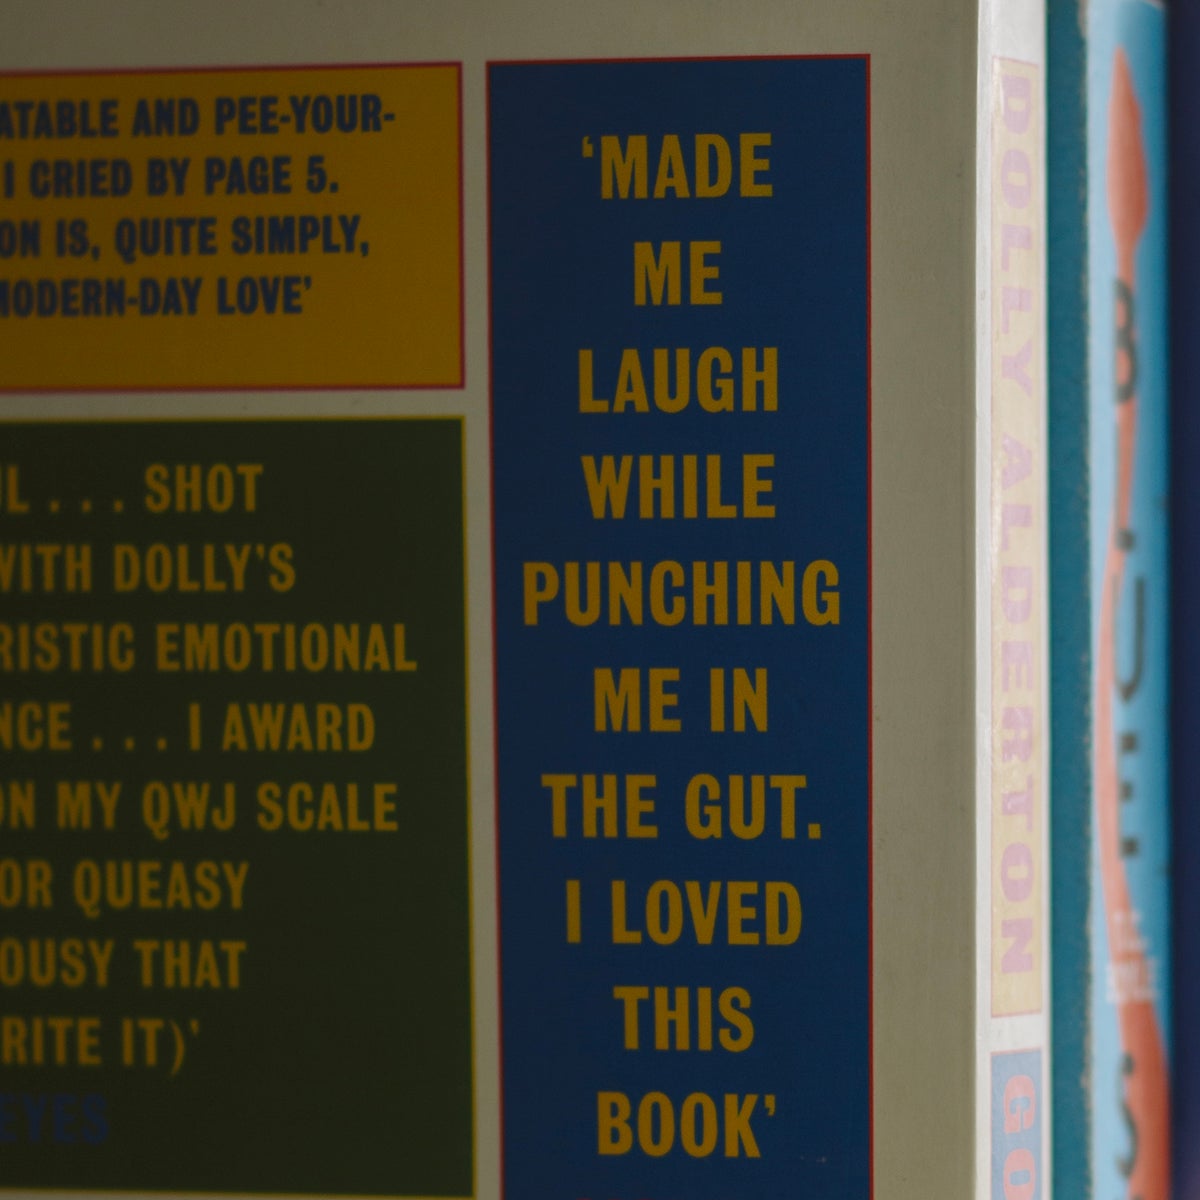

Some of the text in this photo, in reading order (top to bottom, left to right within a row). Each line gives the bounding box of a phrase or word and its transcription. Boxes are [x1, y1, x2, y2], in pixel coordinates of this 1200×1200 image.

[132, 98, 199, 137] AND
[215, 94, 396, 135] PEE-YOUR-
[4, 155, 339, 199] I CRIED BY PAGE 5.
[56, 218, 100, 261] IS,
[115, 216, 217, 264] QUITE
[231, 214, 369, 256] SIMPLY,
[634, 241, 723, 306] ME
[578, 347, 779, 414] LAUGH
[144, 463, 263, 513] SHOT
[581, 454, 776, 519] WHILE
[1000, 74, 1034, 974] DOLLY ALDERTON
[114, 542, 296, 592] DOLLY'S
[523, 560, 841, 627] PUNCHING
[157, 623, 417, 671] EMOTIONAL
[189, 704, 200, 750] I
[222, 703, 375, 751] AWARD
[593, 668, 768, 733] ME IN
[57, 782, 121, 829] MY
[142, 782, 235, 840] QWJ
[257, 783, 398, 831] SCALE
[541, 774, 821, 840] THE GUT.
[74, 860, 249, 918] QUEASY
[566, 880, 802, 946] I LOVED
[0, 939, 247, 988] OUSY THAT
[3, 1018, 101, 1066] RITE
[613, 986, 754, 1053] THIS
